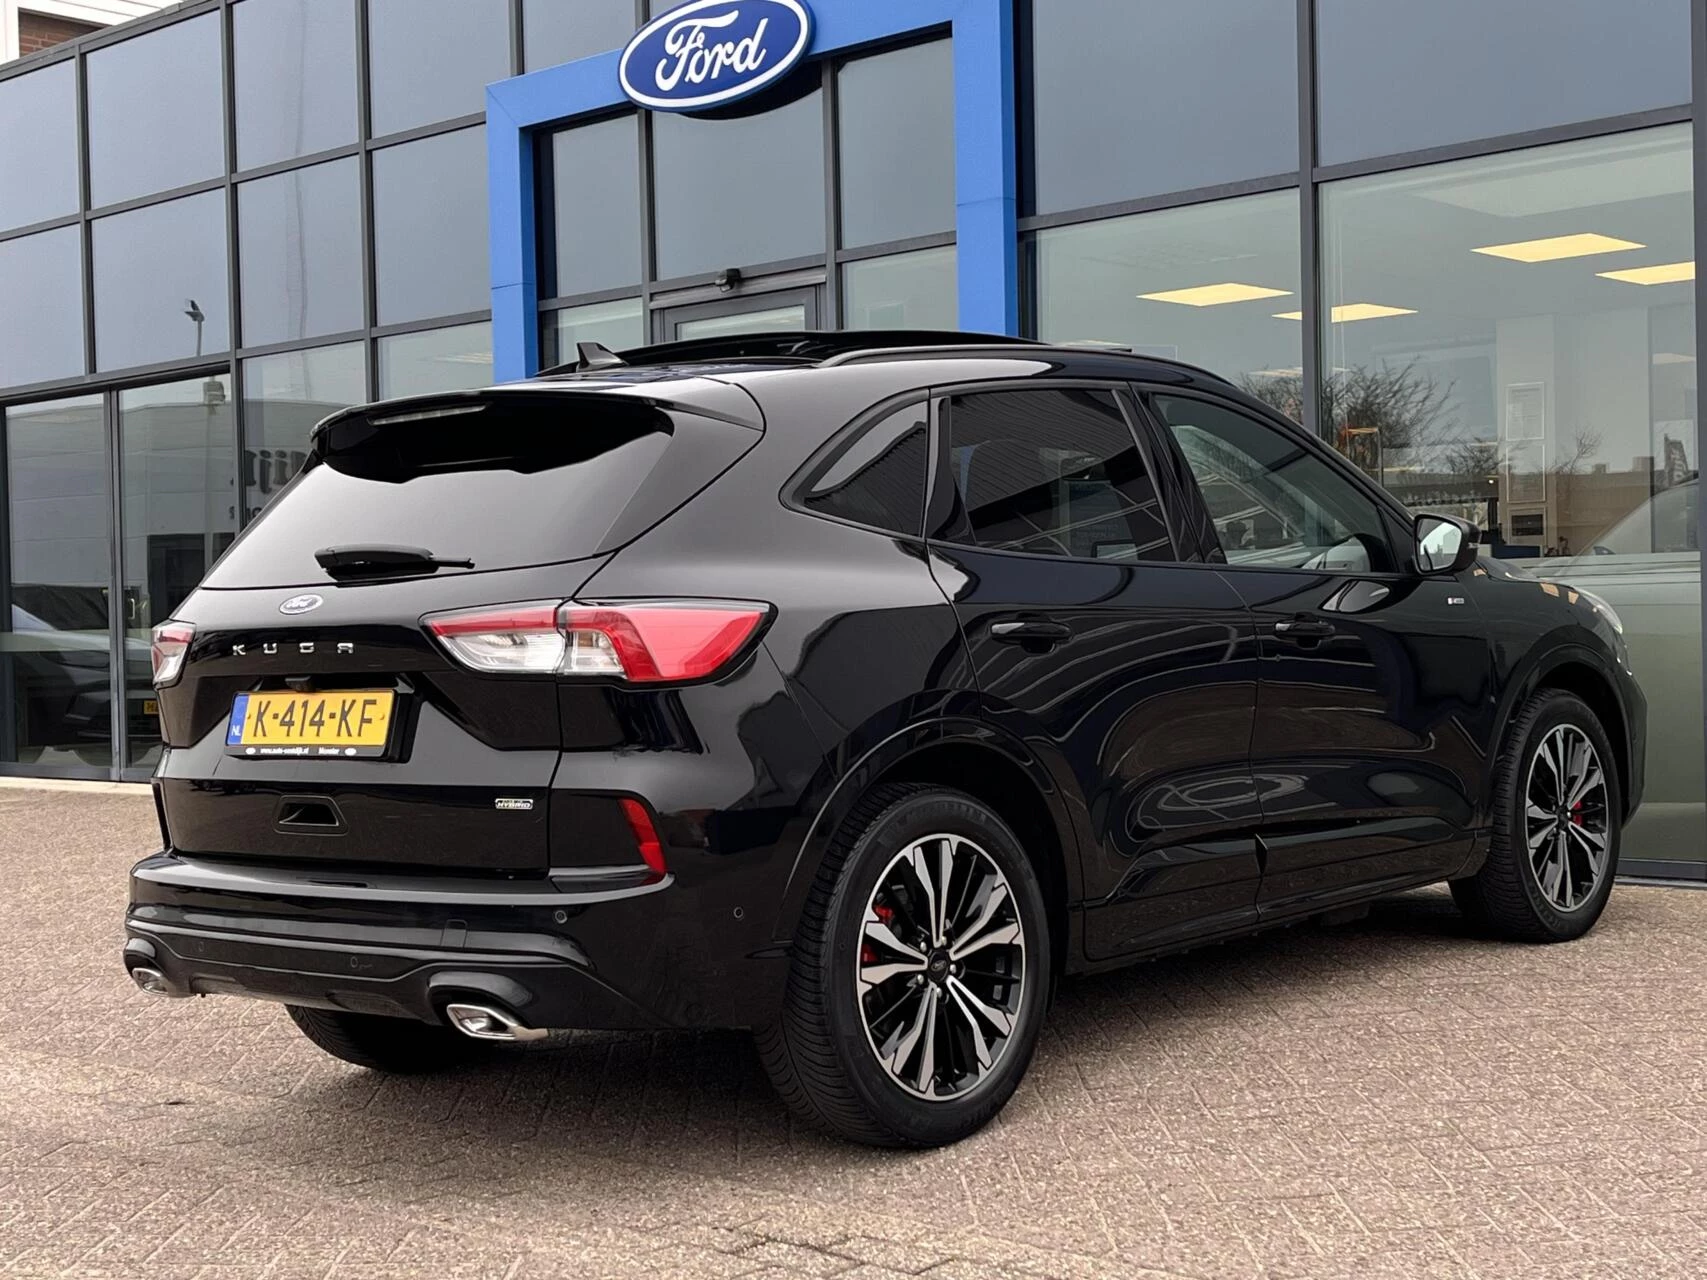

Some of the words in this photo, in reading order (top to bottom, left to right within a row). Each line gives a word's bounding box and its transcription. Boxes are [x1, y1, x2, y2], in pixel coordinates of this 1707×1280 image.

[655, 10, 769, 91] Ford
[232, 642, 354, 656] KUGA
[231, 724, 241, 736] NL
[252, 698, 378, 738] K-414-KF
